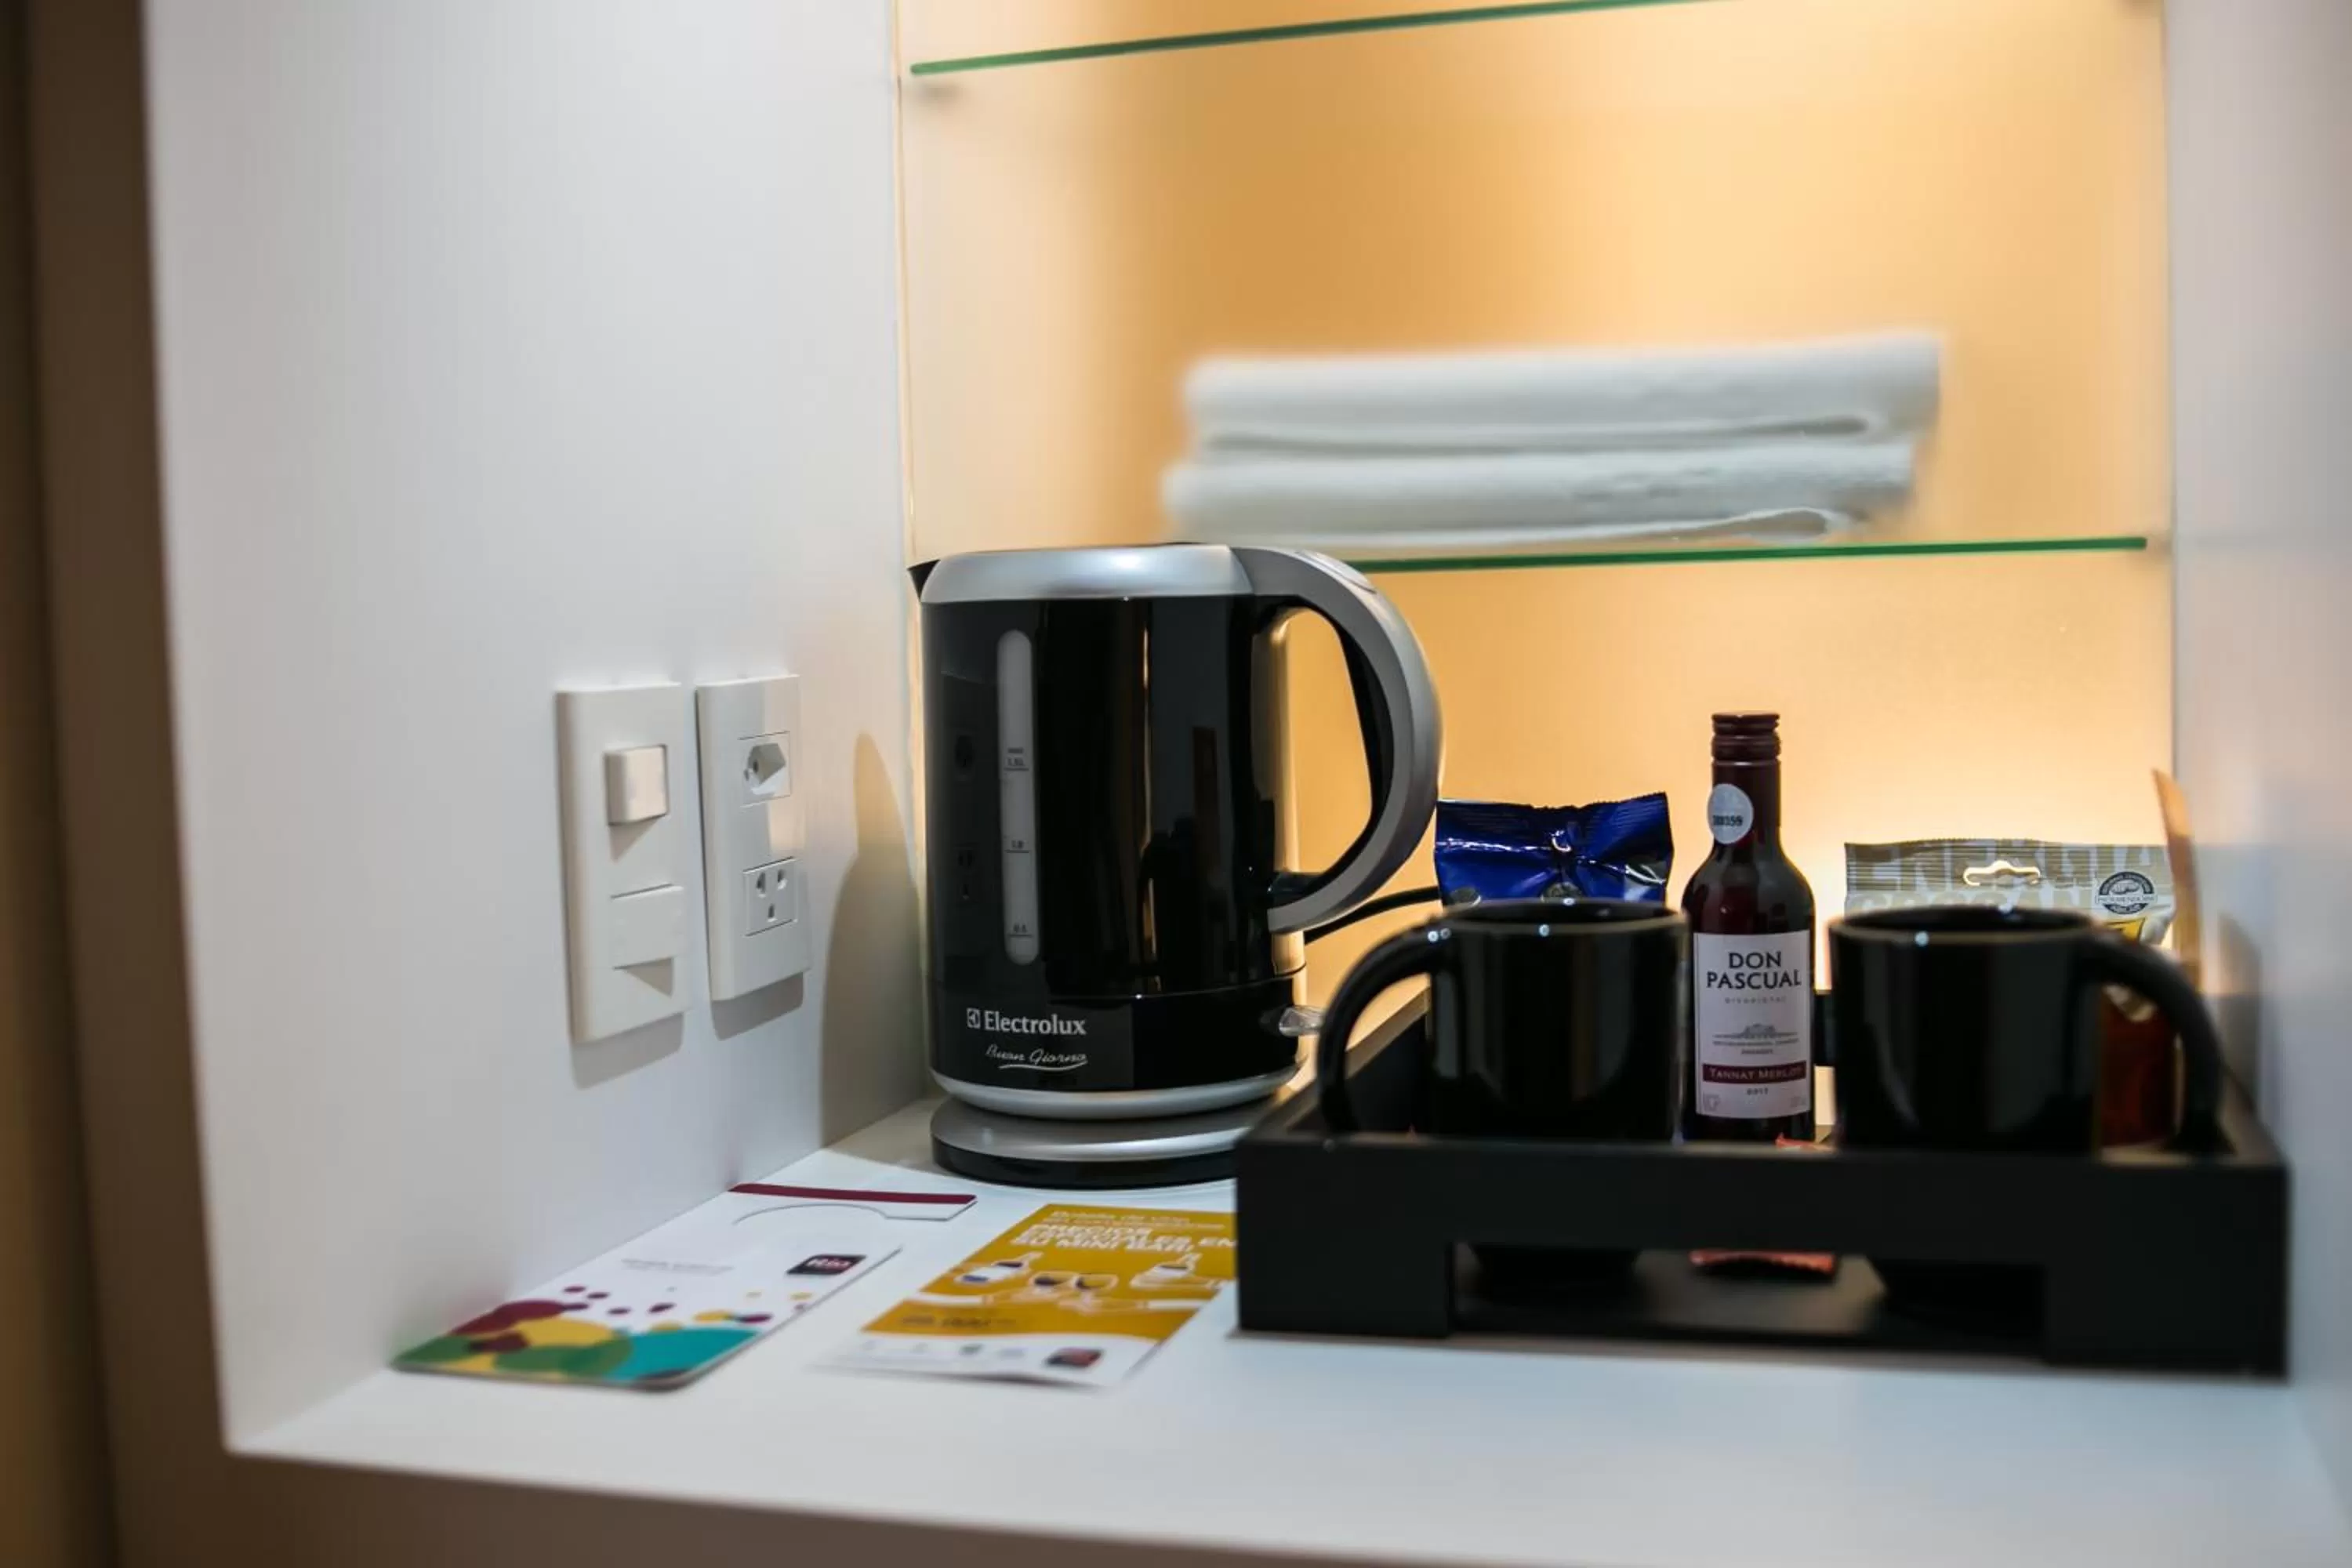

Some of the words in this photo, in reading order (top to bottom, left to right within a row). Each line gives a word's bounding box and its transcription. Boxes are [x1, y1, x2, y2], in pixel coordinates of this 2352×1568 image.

[1729, 951, 1781, 969] DON
[1706, 969, 1802, 989] PASCUAL
[984, 1010, 1087, 1036] Electrolux
